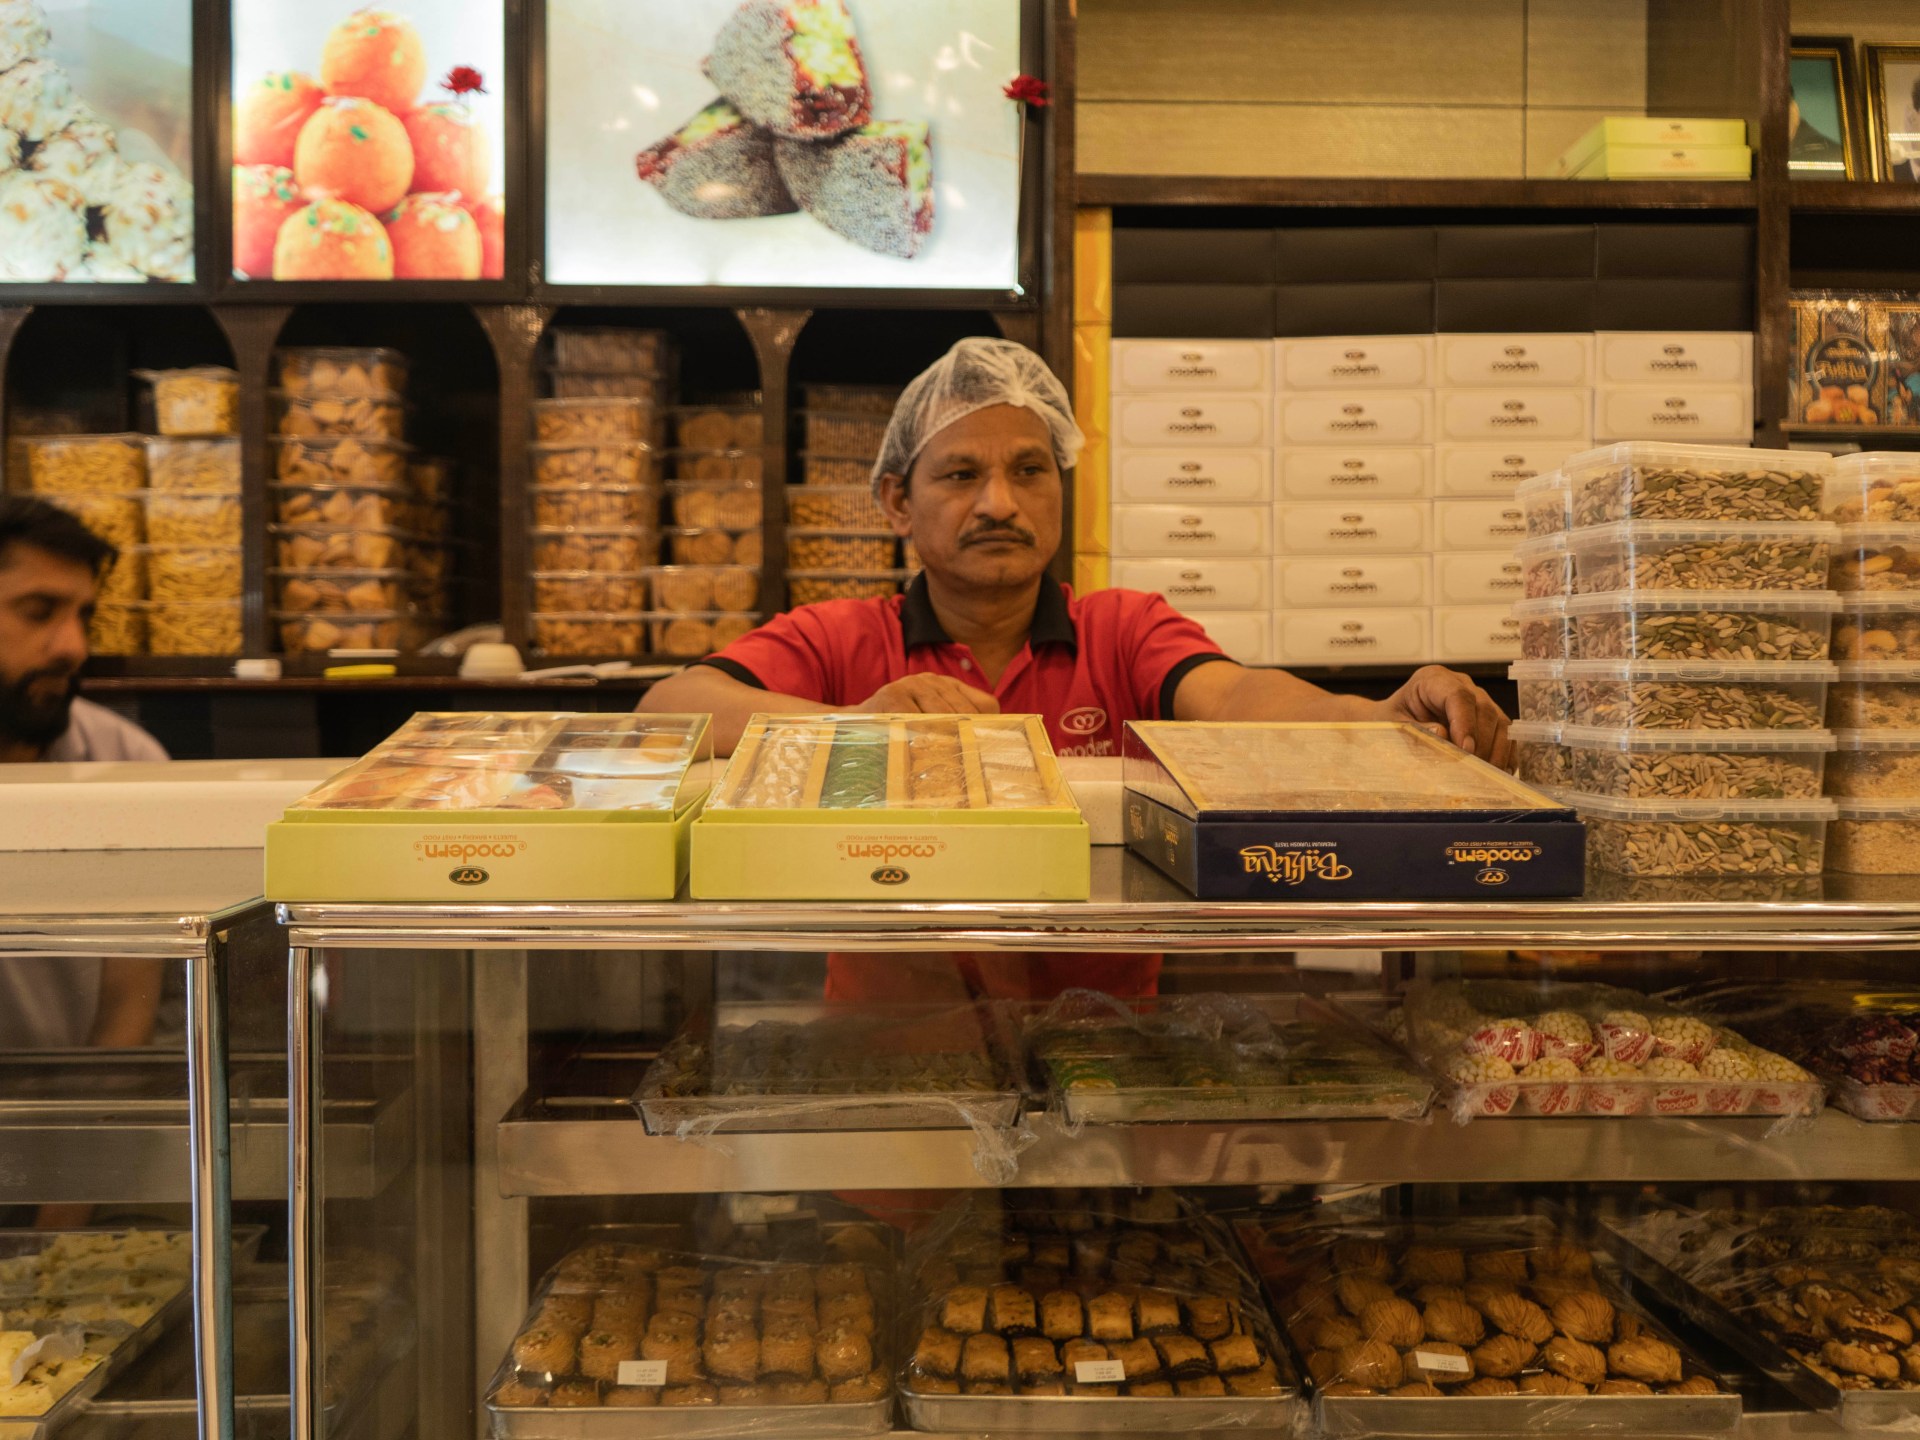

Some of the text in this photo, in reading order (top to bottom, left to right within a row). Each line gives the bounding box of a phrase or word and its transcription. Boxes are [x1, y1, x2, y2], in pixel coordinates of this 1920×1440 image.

[425, 843, 515, 864] modern
[847, 844, 936, 864] modern
[1454, 848, 1532, 867] modern
[1239, 845, 1353, 886] Baklava
